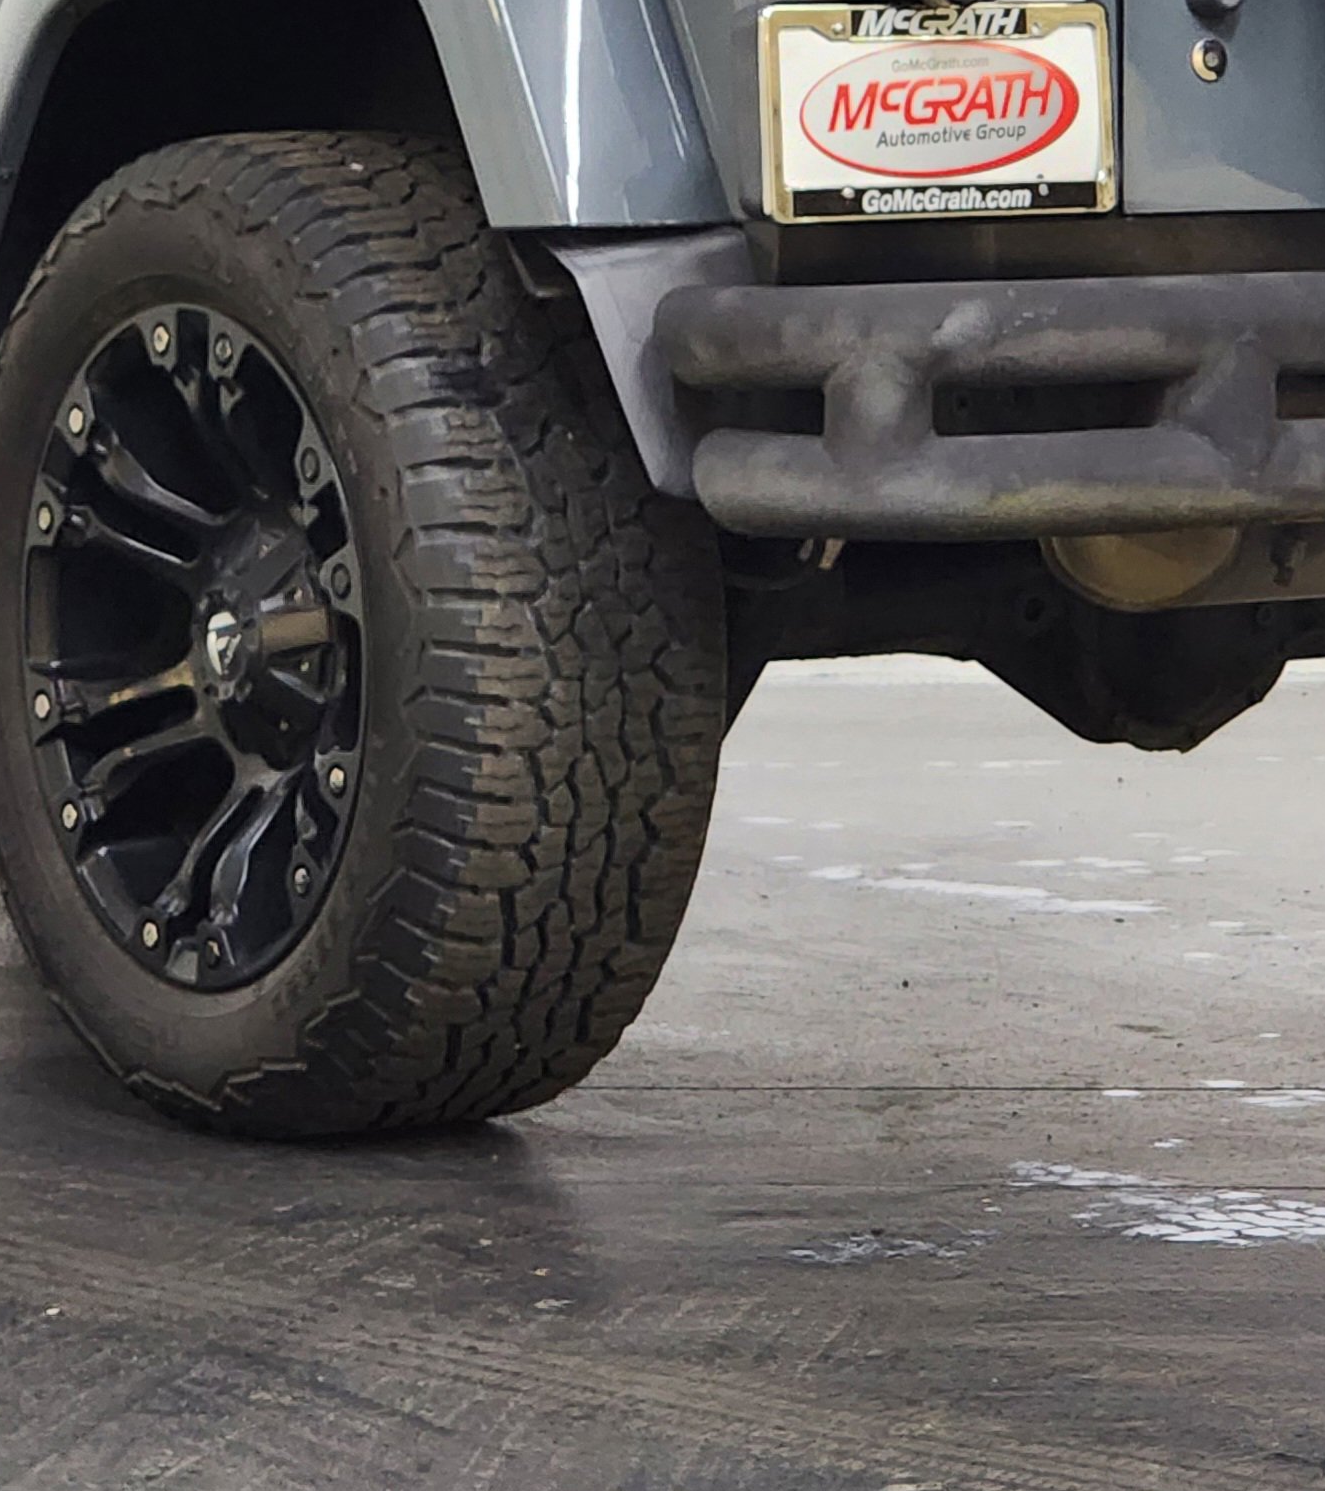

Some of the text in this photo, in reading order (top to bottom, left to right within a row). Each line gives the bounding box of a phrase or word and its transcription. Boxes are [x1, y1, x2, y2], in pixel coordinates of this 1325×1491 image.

[891, 55, 989, 74] GoMcGrath.com
[876, 122, 1026, 149] Automotive Group
[861, 186, 1032, 214] GoMcGrath.com
